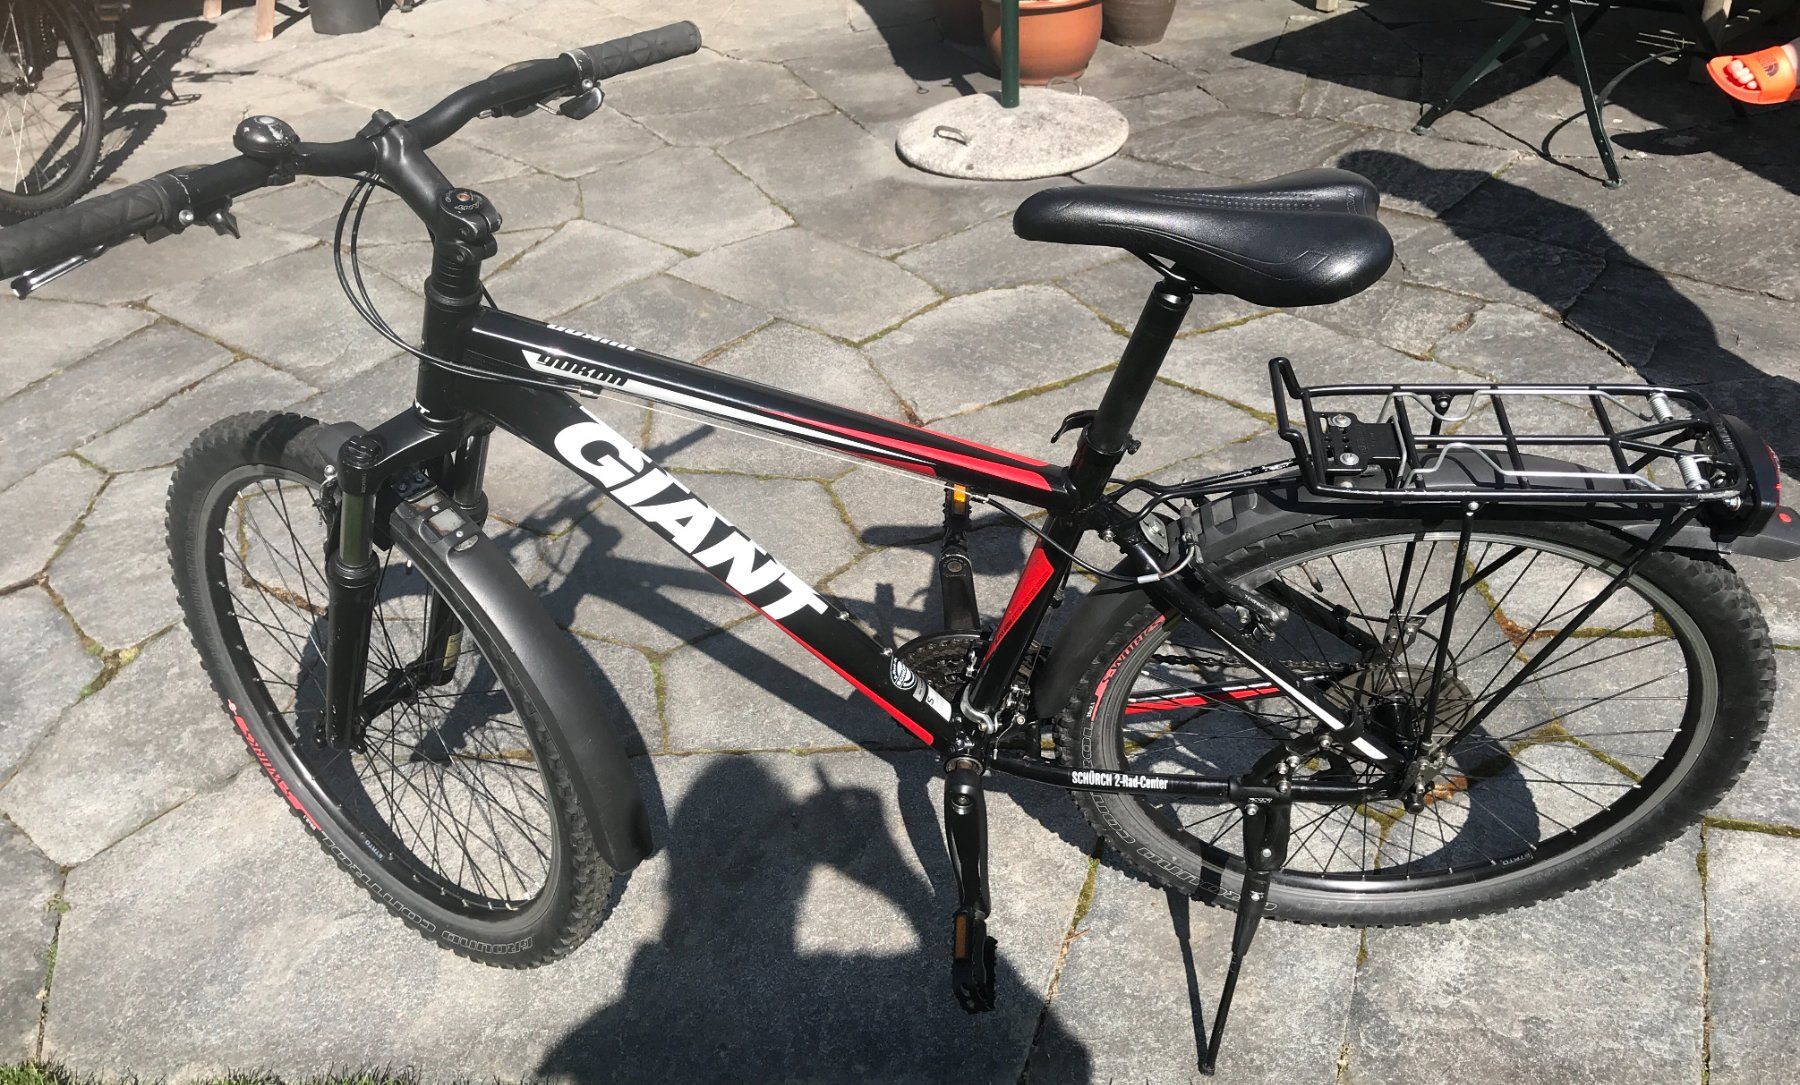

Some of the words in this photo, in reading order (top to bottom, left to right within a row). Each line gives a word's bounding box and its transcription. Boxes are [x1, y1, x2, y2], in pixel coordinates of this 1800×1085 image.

[554, 421, 829, 620] GIANT
[1071, 770, 1113, 786] SCHÜRCH
[1114, 774, 1169, 790] 2-Rad-Center
[321, 831, 437, 933] CONTROL
[441, 930, 533, 955] GROUND
